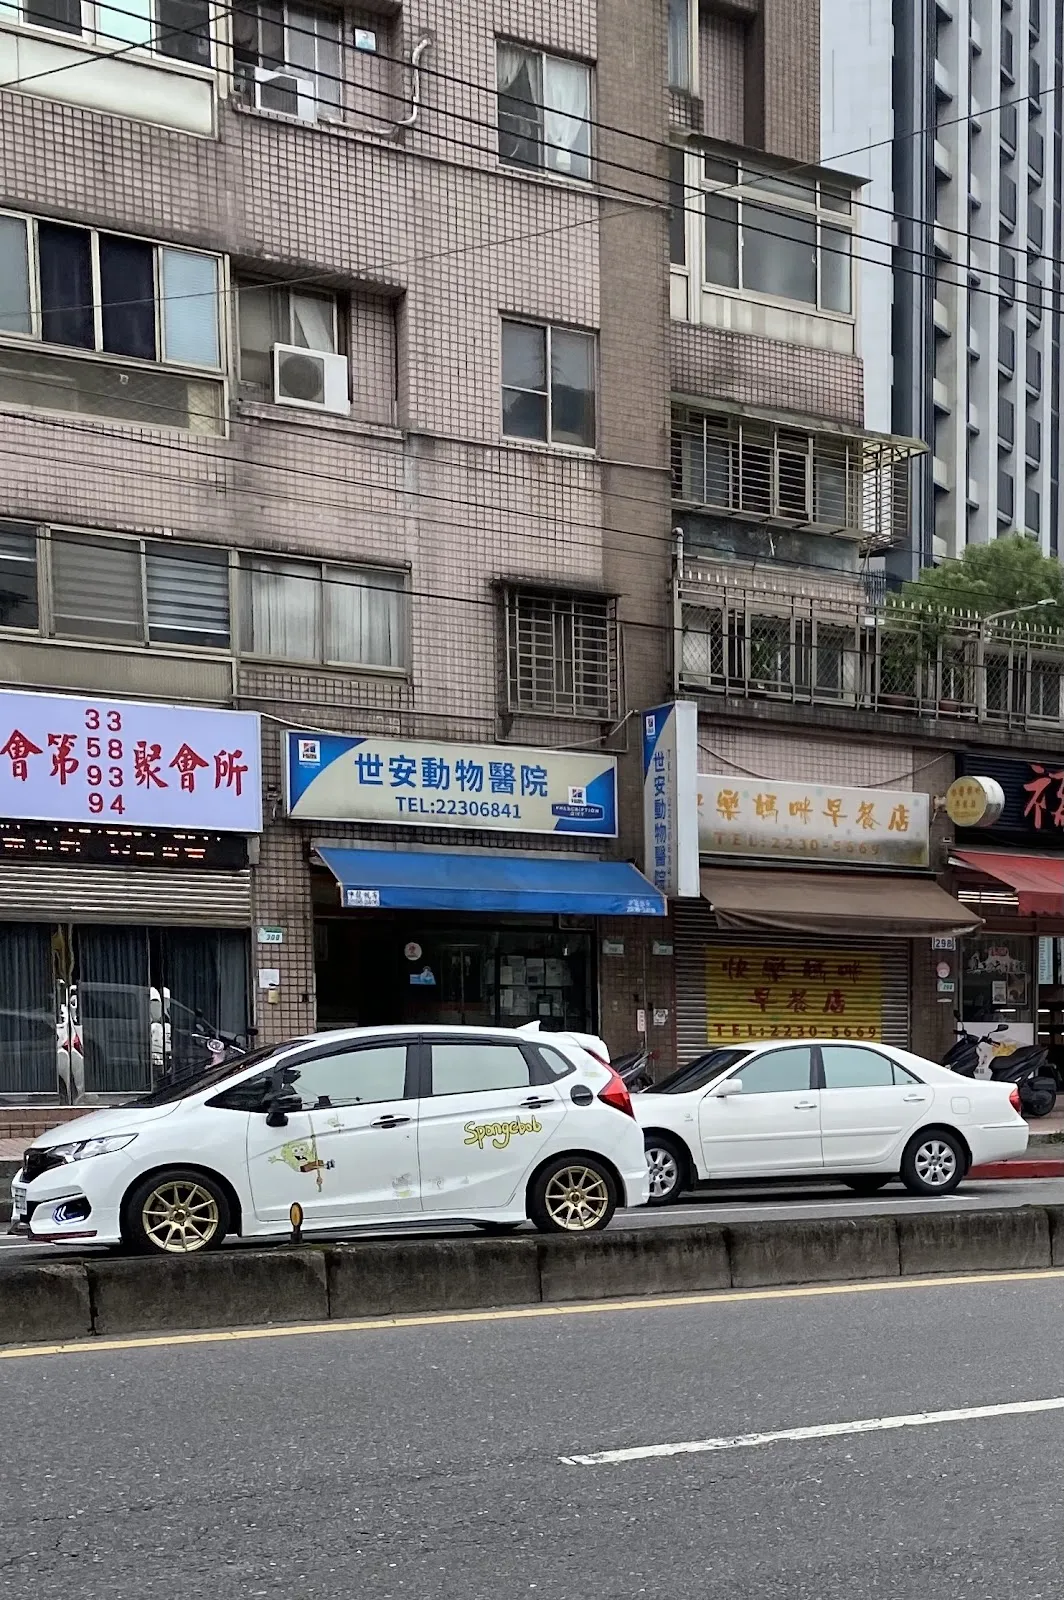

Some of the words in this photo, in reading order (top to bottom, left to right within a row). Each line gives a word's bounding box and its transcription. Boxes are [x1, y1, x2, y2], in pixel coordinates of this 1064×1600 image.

[85, 708, 122, 732] 33
[0, 729, 79, 786] 會第
[86, 736, 123, 760] 58
[86, 765, 124, 788] 93
[133, 740, 249, 797] 聚會所
[354, 752, 549, 798] 世安動物醫院
[88, 792, 126, 815] 94
[395, 796, 522, 819] TEL:22306841
[653, 750, 667, 890] 世安動物醫院
[722, 954, 863, 983] 快樂媽咪
[748, 986, 848, 1014] 早餐店
[713, 1022, 877, 1039] TEL:2230-5669
[463, 1114, 543, 1150] Spongebob
